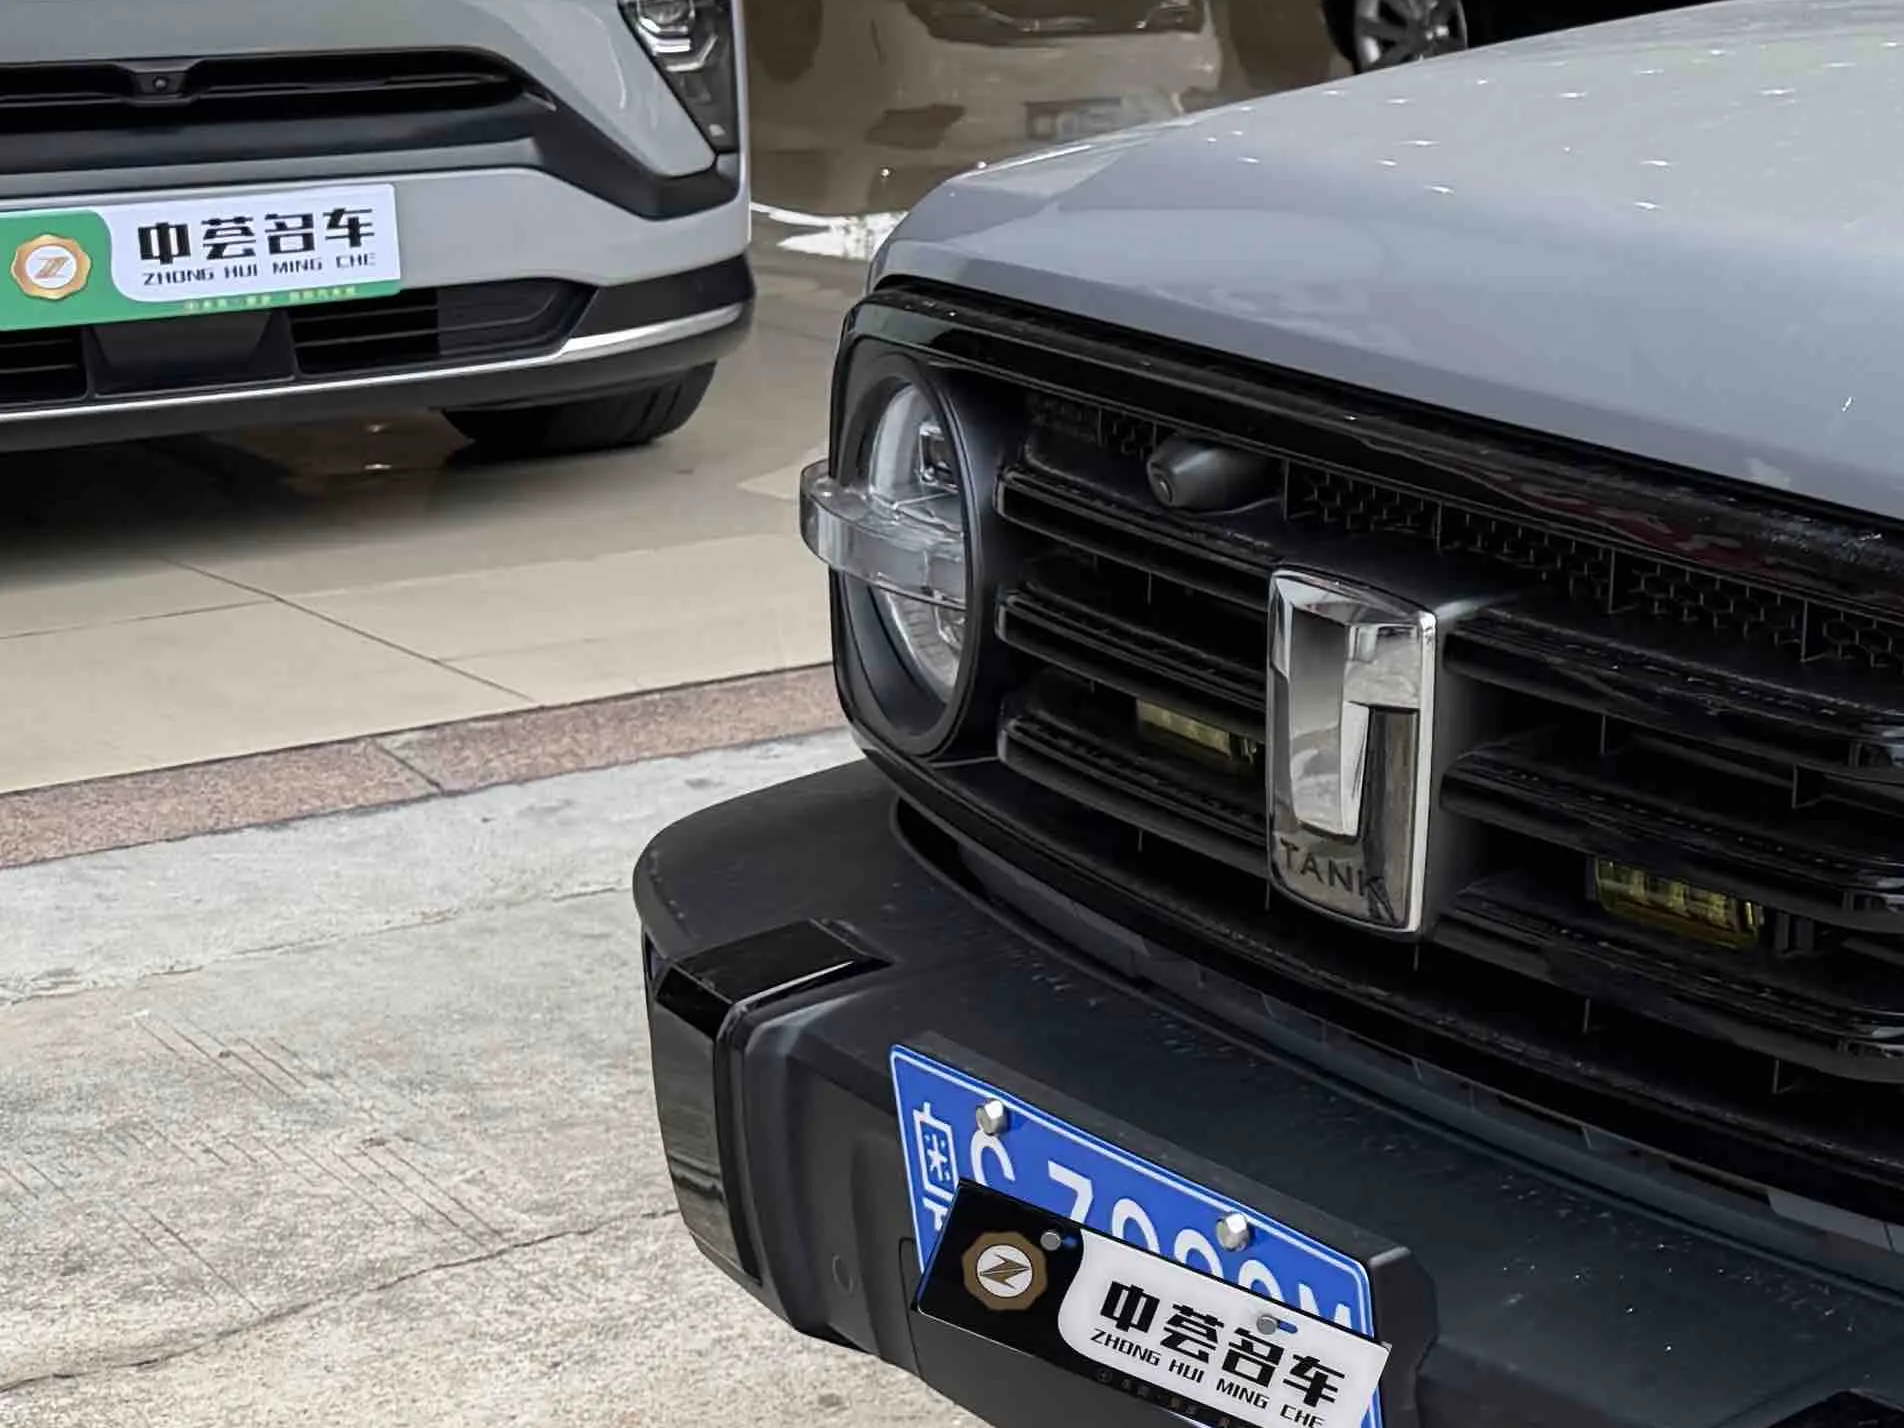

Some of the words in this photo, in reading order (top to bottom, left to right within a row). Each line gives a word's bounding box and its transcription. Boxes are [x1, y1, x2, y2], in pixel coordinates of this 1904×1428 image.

[137, 206, 376, 266] 中荟名车
[142, 266, 216, 287] ZHONG
[223, 262, 259, 280] HUI
[271, 257, 324, 274] MING
[335, 251, 376, 270] CHE
[1090, 1328, 1161, 1368] ZHONG
[1168, 1358, 1205, 1384] HUI
[1216, 1377, 1271, 1410] MING
[1099, 1279, 1347, 1409] 中荟名车
